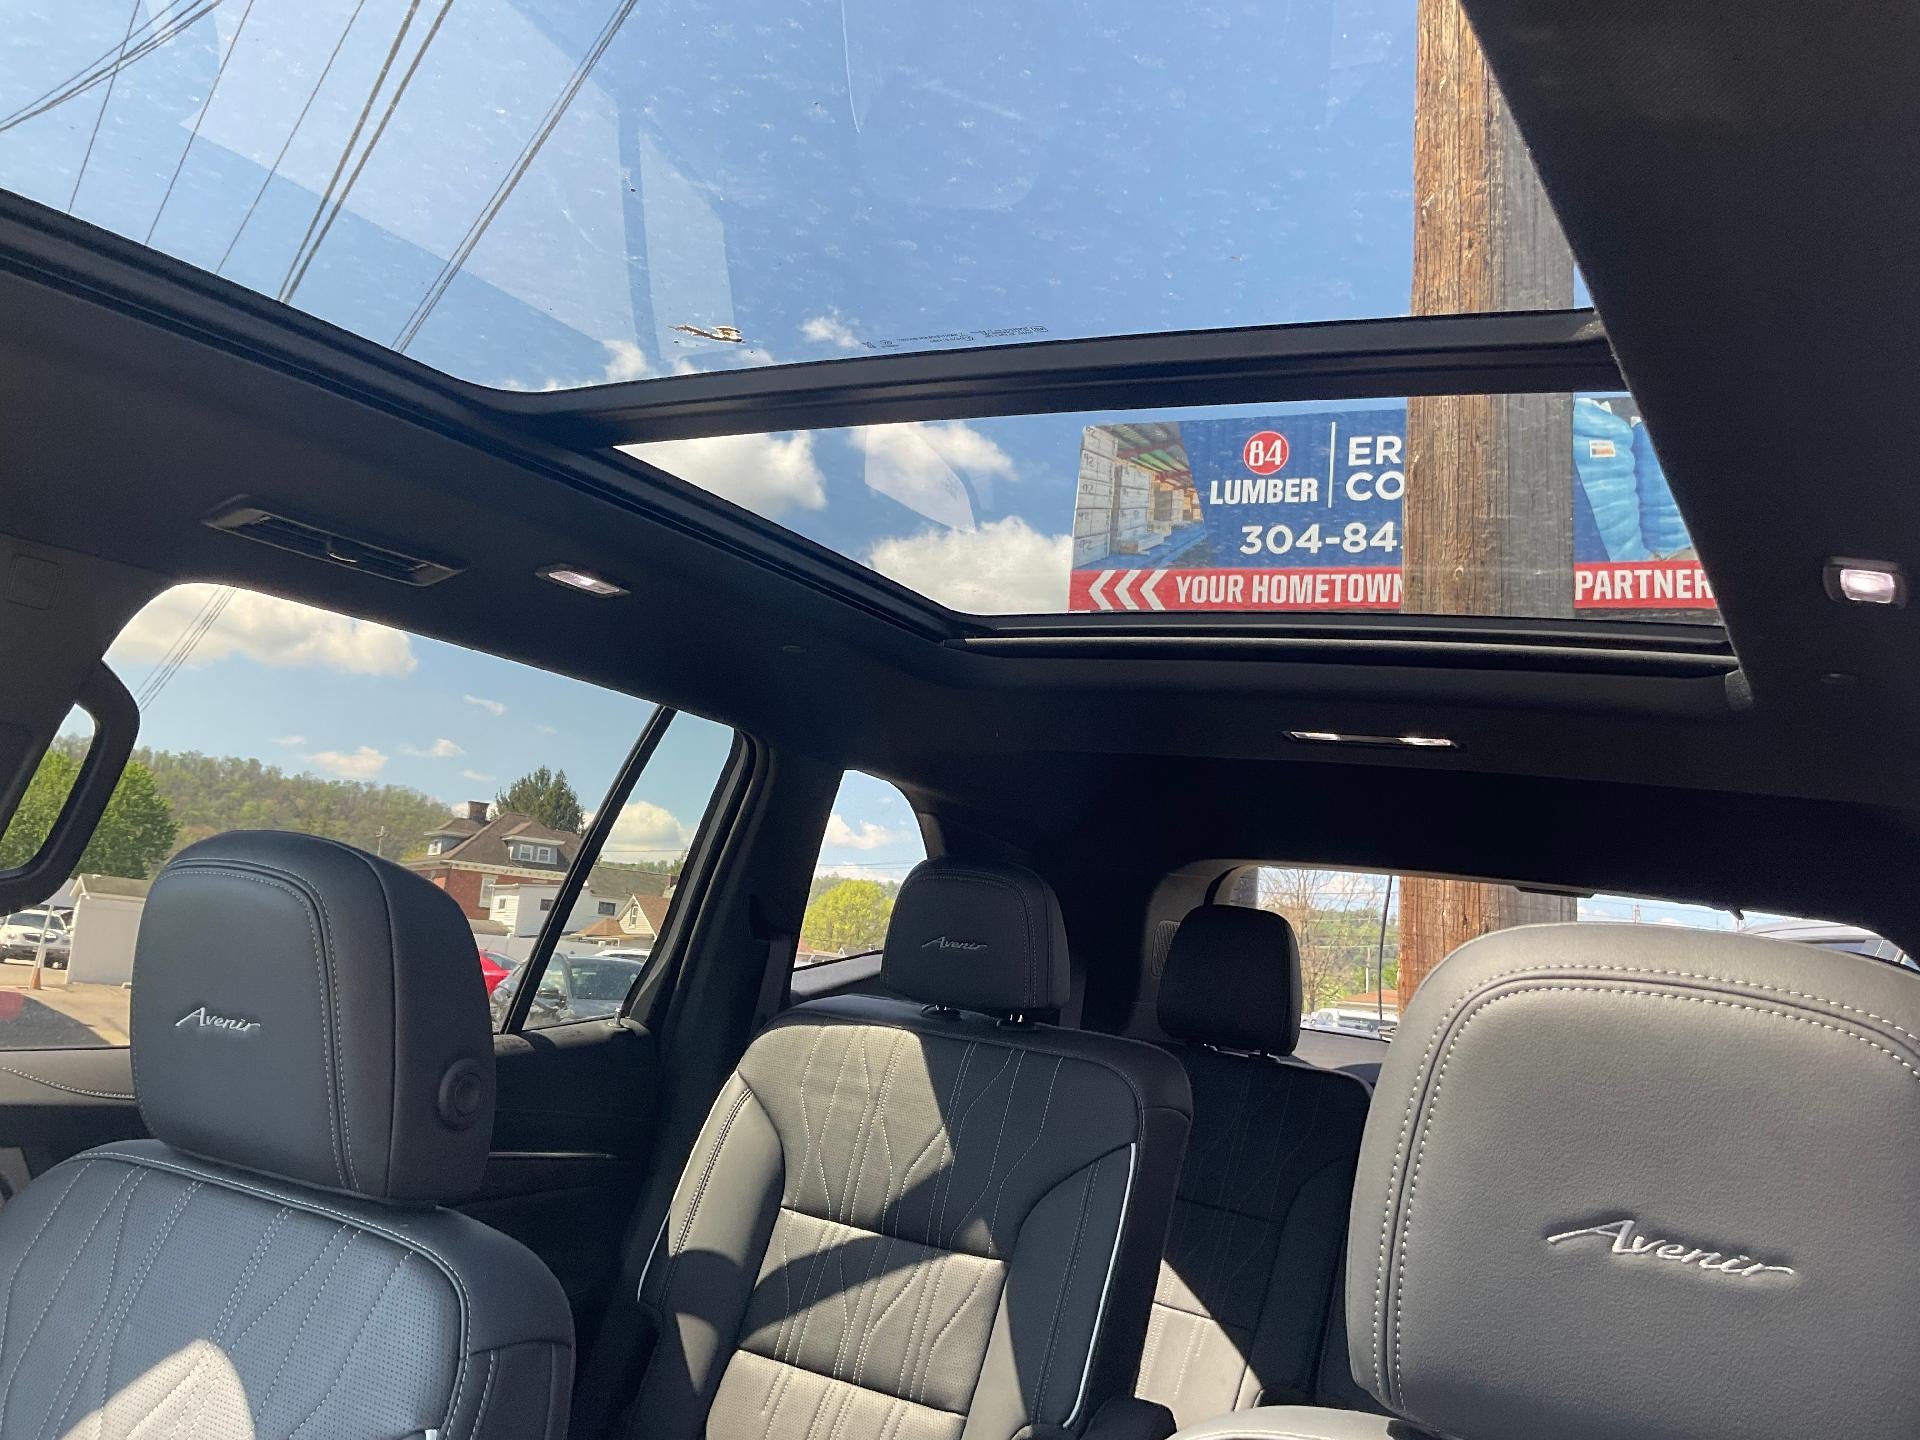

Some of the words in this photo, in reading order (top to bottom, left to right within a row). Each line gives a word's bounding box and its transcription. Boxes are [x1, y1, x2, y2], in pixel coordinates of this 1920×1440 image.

[1249, 440, 1282, 467] 84
[1209, 477, 1319, 505] LUMBER
[1239, 521, 1404, 555] 304-84
[1176, 575, 1244, 604] YOUR
[1575, 568, 1714, 600] PARTNER
[921, 936, 988, 950] Avenir
[175, 1006, 261, 1032] Avenir
[1546, 1219, 1795, 1277] Avenir
